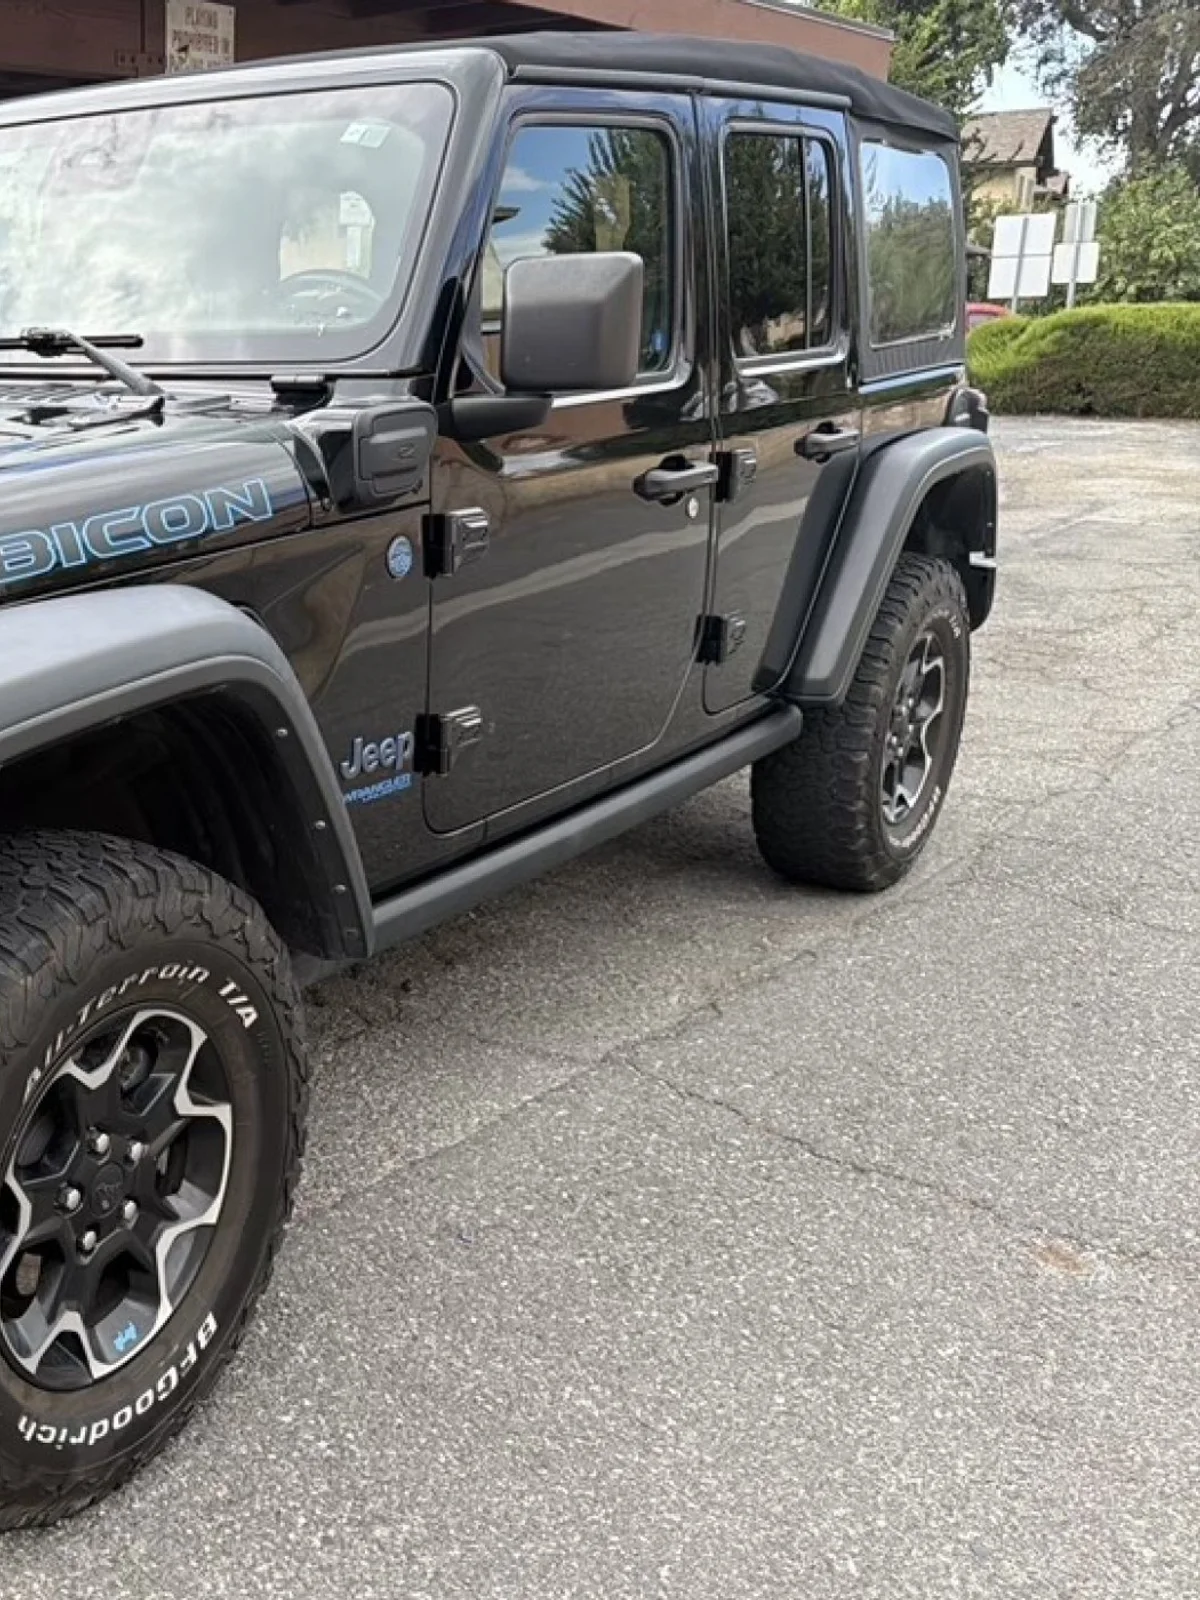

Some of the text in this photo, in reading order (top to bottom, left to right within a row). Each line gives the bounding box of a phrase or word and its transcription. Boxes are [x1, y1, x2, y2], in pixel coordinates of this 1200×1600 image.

[340, 731, 414, 779] Jeep
[218, 976, 259, 1029] T/A
[17, 1310, 218, 1450] BFGoodrich
